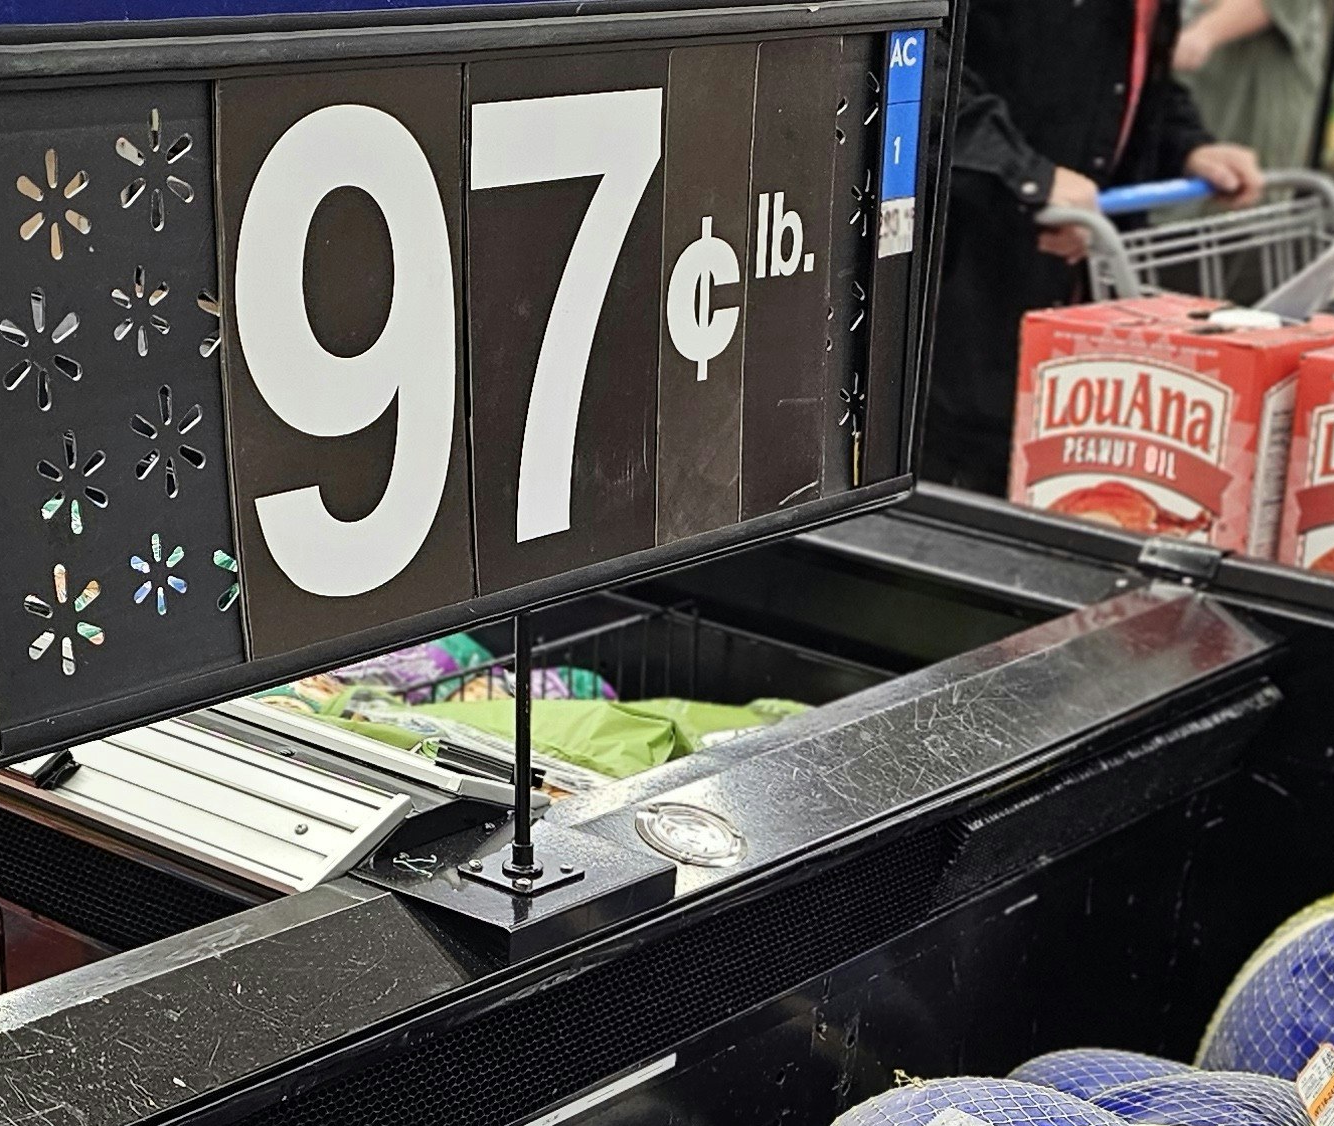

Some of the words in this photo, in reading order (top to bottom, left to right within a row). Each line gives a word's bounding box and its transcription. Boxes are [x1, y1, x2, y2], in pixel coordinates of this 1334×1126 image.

[890, 37, 917, 68] AC
[893, 136, 902, 165] 1
[756, 191, 813, 279] lb.
[1042, 371, 1215, 452] LouAna
[1063, 436, 1138, 467] PEANUT
[1144, 450, 1178, 480] OIL
